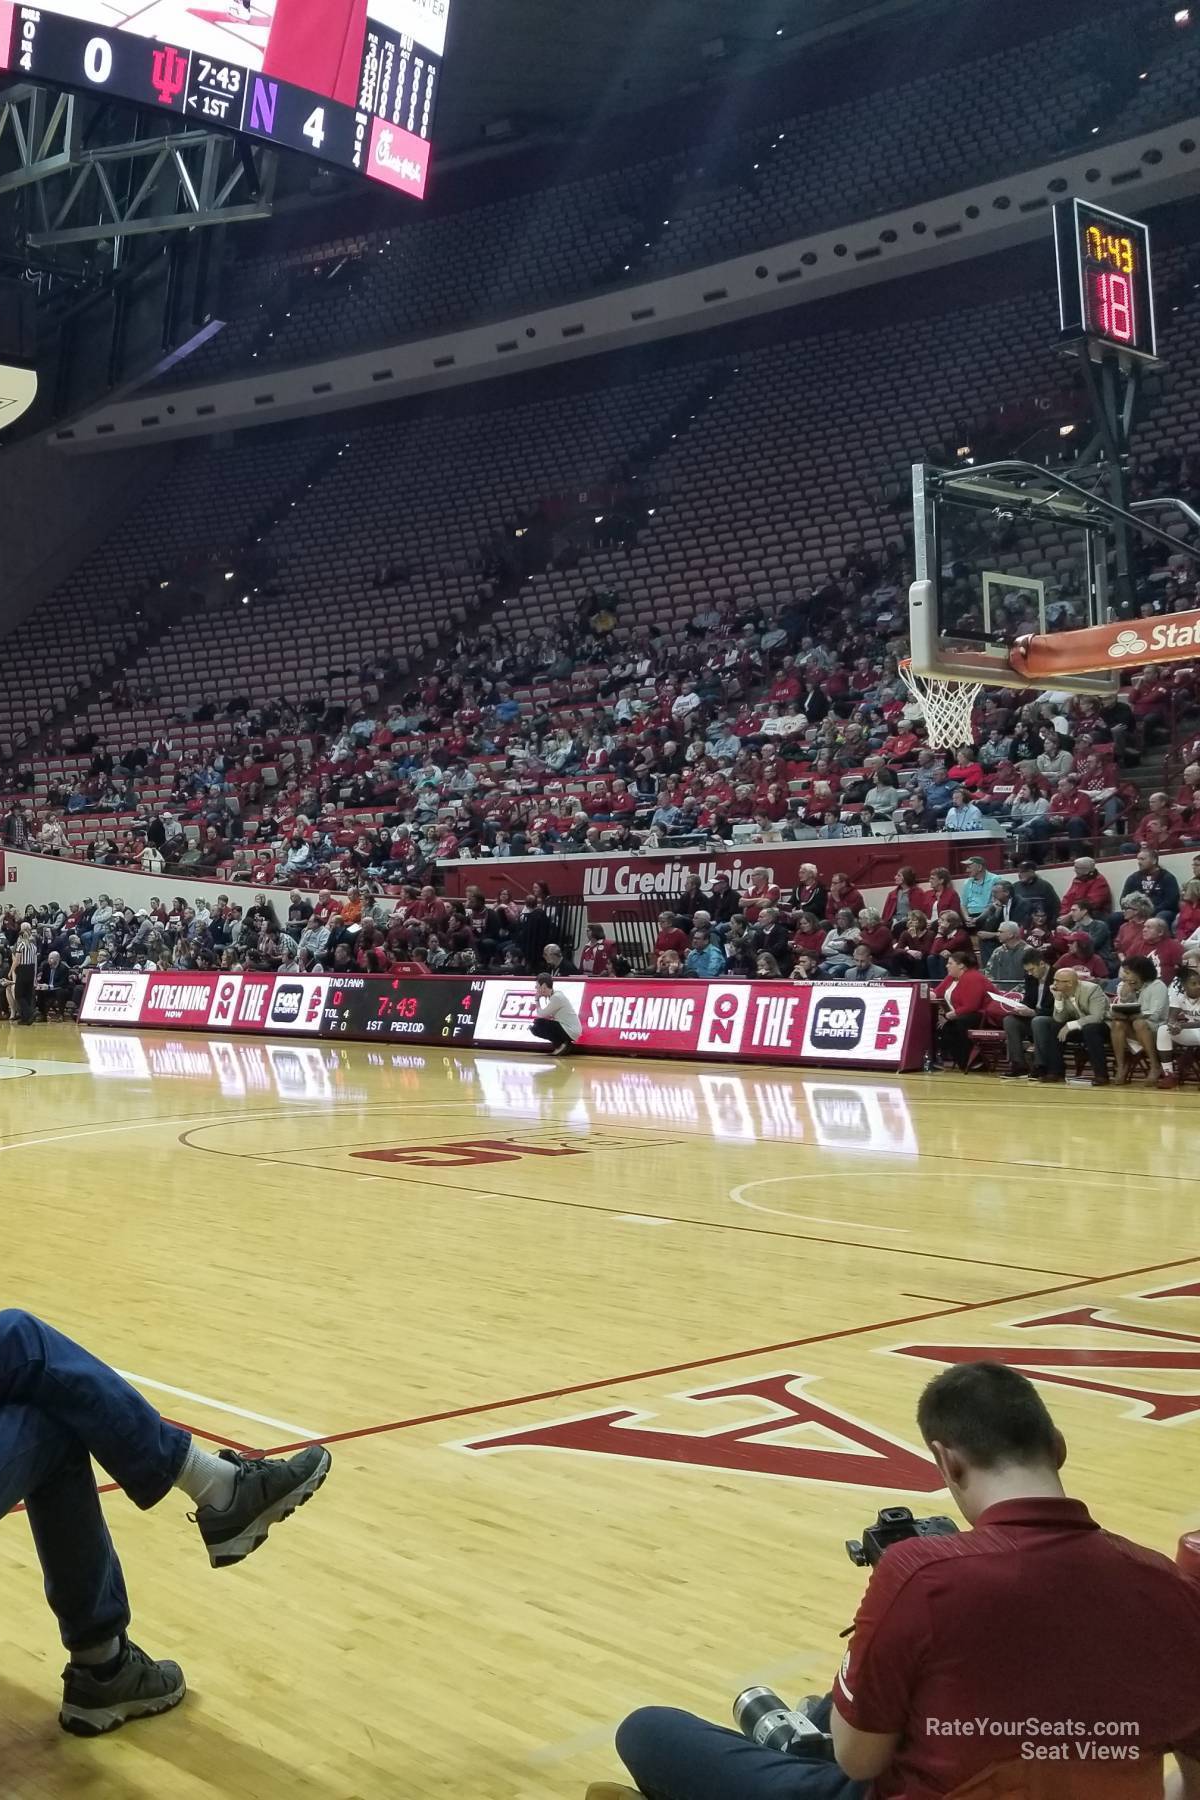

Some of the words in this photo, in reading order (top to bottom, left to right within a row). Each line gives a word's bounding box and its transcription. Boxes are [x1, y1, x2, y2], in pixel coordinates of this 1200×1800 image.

[24, 21, 36, 40] 0
[20, 52, 32, 70] 4
[84, 37, 112, 83] 0
[198, 60, 241, 92] 7:43
[202, 96, 229, 119] 1ST
[250, 78, 278, 134] N
[302, 106, 325, 149] 4
[1088, 226, 1134, 274] 7:43
[584, 867, 608, 895] IU
[100, 985, 132, 1002] BTN
[329, 979, 364, 988] INDIANA
[470, 981, 484, 992] NU
[148, 985, 210, 1010] STREAMING
[238, 984, 269, 1022] THE
[276, 992, 301, 1008] FOX
[333, 991, 343, 1006] 0
[378, 997, 418, 1018] 7:43
[462, 994, 472, 1010] 4
[324, 1008, 339, 1018] TOL
[456, 1014, 474, 1024] TOL
[587, 996, 693, 1032] STREAMING
[751, 997, 799, 1047] THE
[817, 1008, 861, 1030] FOX
[366, 1022, 383, 1031] 1ST
[390, 1022, 424, 1033] PERIOD
[620, 1031, 650, 1042] NOW
[814, 1028, 859, 1038] SPORTS
